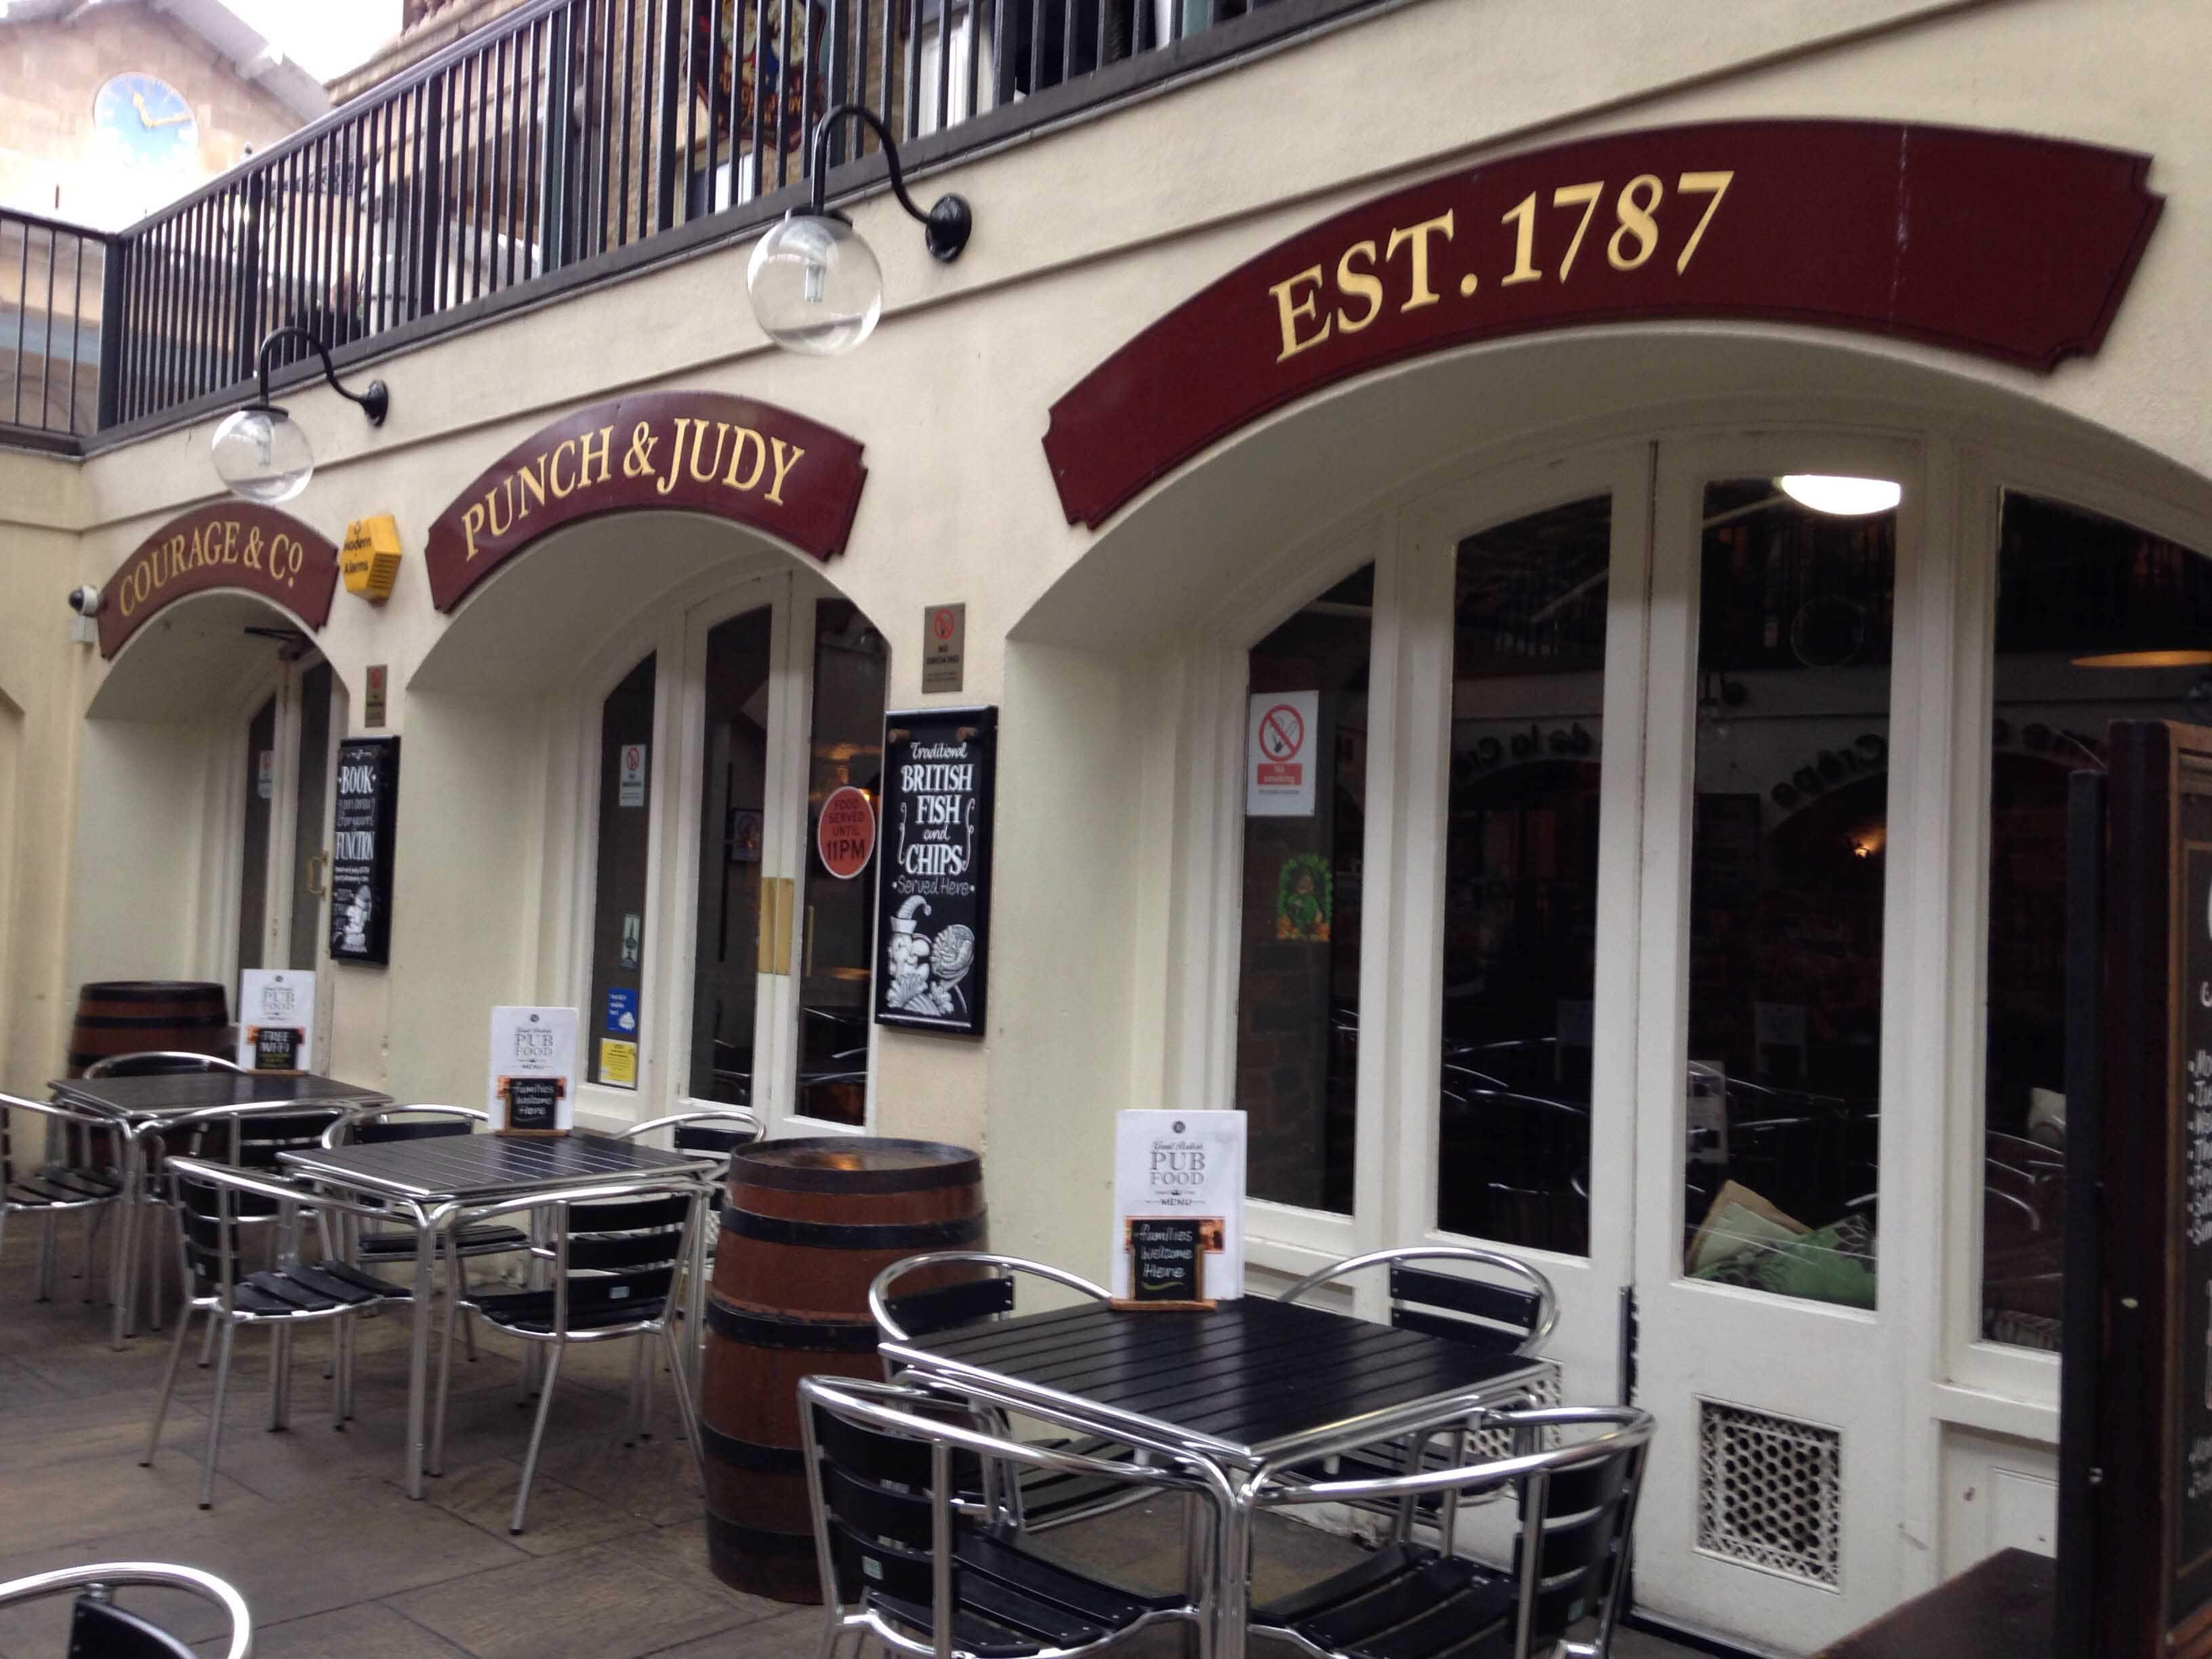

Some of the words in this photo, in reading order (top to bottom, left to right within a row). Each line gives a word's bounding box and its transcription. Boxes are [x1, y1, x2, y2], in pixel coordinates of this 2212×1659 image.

[1268, 207, 1478, 364] EST.
[1501, 170, 1735, 287] 1787
[461, 425, 614, 562] PUNCH
[622, 421, 659, 477] &
[656, 417, 805, 507] JUDY
[119, 520, 241, 617] COURAGE
[243, 525, 265, 571] &
[910, 741, 968, 760] Traditional
[341, 764, 373, 795] BOOK
[900, 763, 975, 793] BRITISH
[828, 811, 865, 823] SERVED
[915, 794, 962, 825] FISH
[922, 825, 951, 841] and
[904, 843, 964, 876] CHIPS
[897, 874, 940, 896] Served
[941, 877, 970, 897] Here
[264, 991, 294, 1002] PUB
[515, 1034, 554, 1047] PUB
[515, 1047, 553, 1057] FOOD
[1149, 1151, 1206, 1171] PUB
[1149, 1172, 1204, 1185] FOOD
[1160, 1198, 1192, 1206] MENU
[1143, 1263, 1186, 1279] Here
